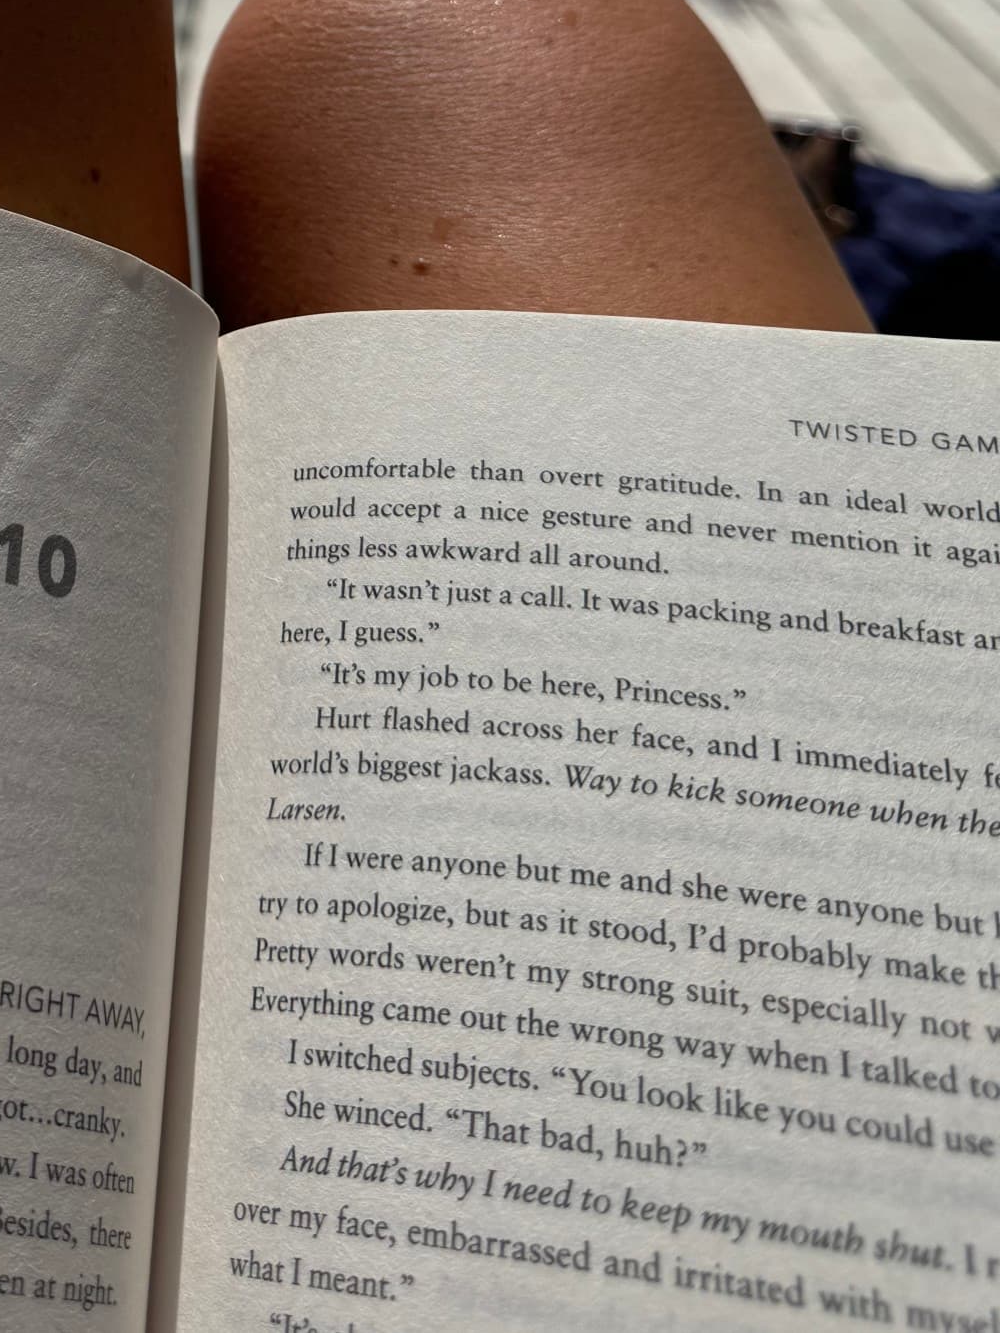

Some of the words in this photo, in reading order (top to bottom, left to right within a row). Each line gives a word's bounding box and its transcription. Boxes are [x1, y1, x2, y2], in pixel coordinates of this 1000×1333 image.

[787, 418, 919, 449] TWISTED
[293, 456, 458, 484] uncomfortable
[469, 458, 526, 484] than
[538, 469, 606, 490] overt
[617, 475, 743, 501] gratitude.
[756, 480, 785, 505] In
[798, 490, 832, 509] an
[845, 488, 909, 516] ideal
[289, 495, 357, 522] would
[367, 502, 444, 525] accept
[453, 504, 468, 521] a
[479, 499, 531, 525] nice
[541, 509, 634, 532] gesture
[645, 512, 695, 537] and
[706, 522, 779, 544] never
[790, 530, 901, 557] mention
[913, 534, 934, 561] it
[286, 537, 352, 566] things
[357, 535, 399, 560] less
[405, 537, 522, 565] awkward
[528, 542, 561, 568] all
[568, 550, 671, 576] around.
[279, 620, 333, 648] here,
[338, 619, 350, 643] I
[353, 621, 442, 650] guess.”
[326, 577, 358, 601] “It
[362, 579, 442, 603] wasn’t
[446, 578, 494, 608] just
[498, 589, 514, 607] a
[519, 584, 574, 611] call.
[580, 588, 603, 613] It
[608, 597, 661, 618] was
[667, 597, 774, 634] packing
[779, 608, 831, 634] and
[837, 610, 967, 649] breakfast
[320, 662, 367, 687] “It’s
[373, 669, 412, 694] my
[418, 663, 461, 694] job
[467, 671, 495, 692] to
[502, 667, 534, 696] be
[540, 669, 606, 705] here,
[614, 677, 748, 713] Princess.”
[265, 796, 347, 823] Larsen.
[269, 749, 351, 777] world’s
[357, 749, 445, 785] biggest
[449, 756, 552, 788] jackass.
[564, 763, 624, 800] Way
[629, 774, 660, 798] to
[667, 772, 727, 806] kick
[734, 788, 862, 821] someone
[869, 799, 950, 833] when
[258, 894, 290, 922] try
[295, 895, 320, 917] to
[326, 891, 456, 930] apologize,
[465, 898, 512, 930] but
[519, 912, 550, 934] as
[558, 908, 580, 938] it
[588, 917, 678, 954] stood,
[687, 922, 728, 955] I’d
[738, 934, 874, 981] probably
[884, 953, 967, 988] make
[84, 996, 147, 1043] AWAY,
[249, 985, 377, 1028] Everything
[381, 1002, 453, 1028] came
[459, 1010, 509, 1034] out
[515, 1006, 561, 1040] the
[568, 1022, 666, 1061] wrong
[673, 1035, 737, 1070] way
[745, 1038, 830, 1077] when
[840, 1049, 853, 1081] I
[861, 1055, 961, 1097] talked
[5, 1034, 59, 1079] long
[64, 1045, 108, 1087] day,
[112, 1059, 144, 1089] and
[284, 1089, 327, 1122] She
[333, 1097, 435, 1135] winced.
[445, 1107, 532, 1147] “That
[540, 1117, 606, 1163] bad,
[614, 1127, 709, 1170] huh?”
[28, 1151, 41, 1182] I
[45, 1162, 88, 1189] was
[91, 1161, 136, 1196] often
[278, 1144, 335, 1178] And
[414, 1161, 477, 1203] why
[482, 1169, 499, 1199] I
[502, 1178, 576, 1211] need
[580, 1188, 613, 1216] to
[620, 1186, 694, 1236] keep
[700, 1210, 752, 1245] my
[89, 1216, 133, 1252] there
[229, 1249, 286, 1286] what
[290, 1256, 304, 1288] I
[307, 1269, 417, 1303] meant.”
